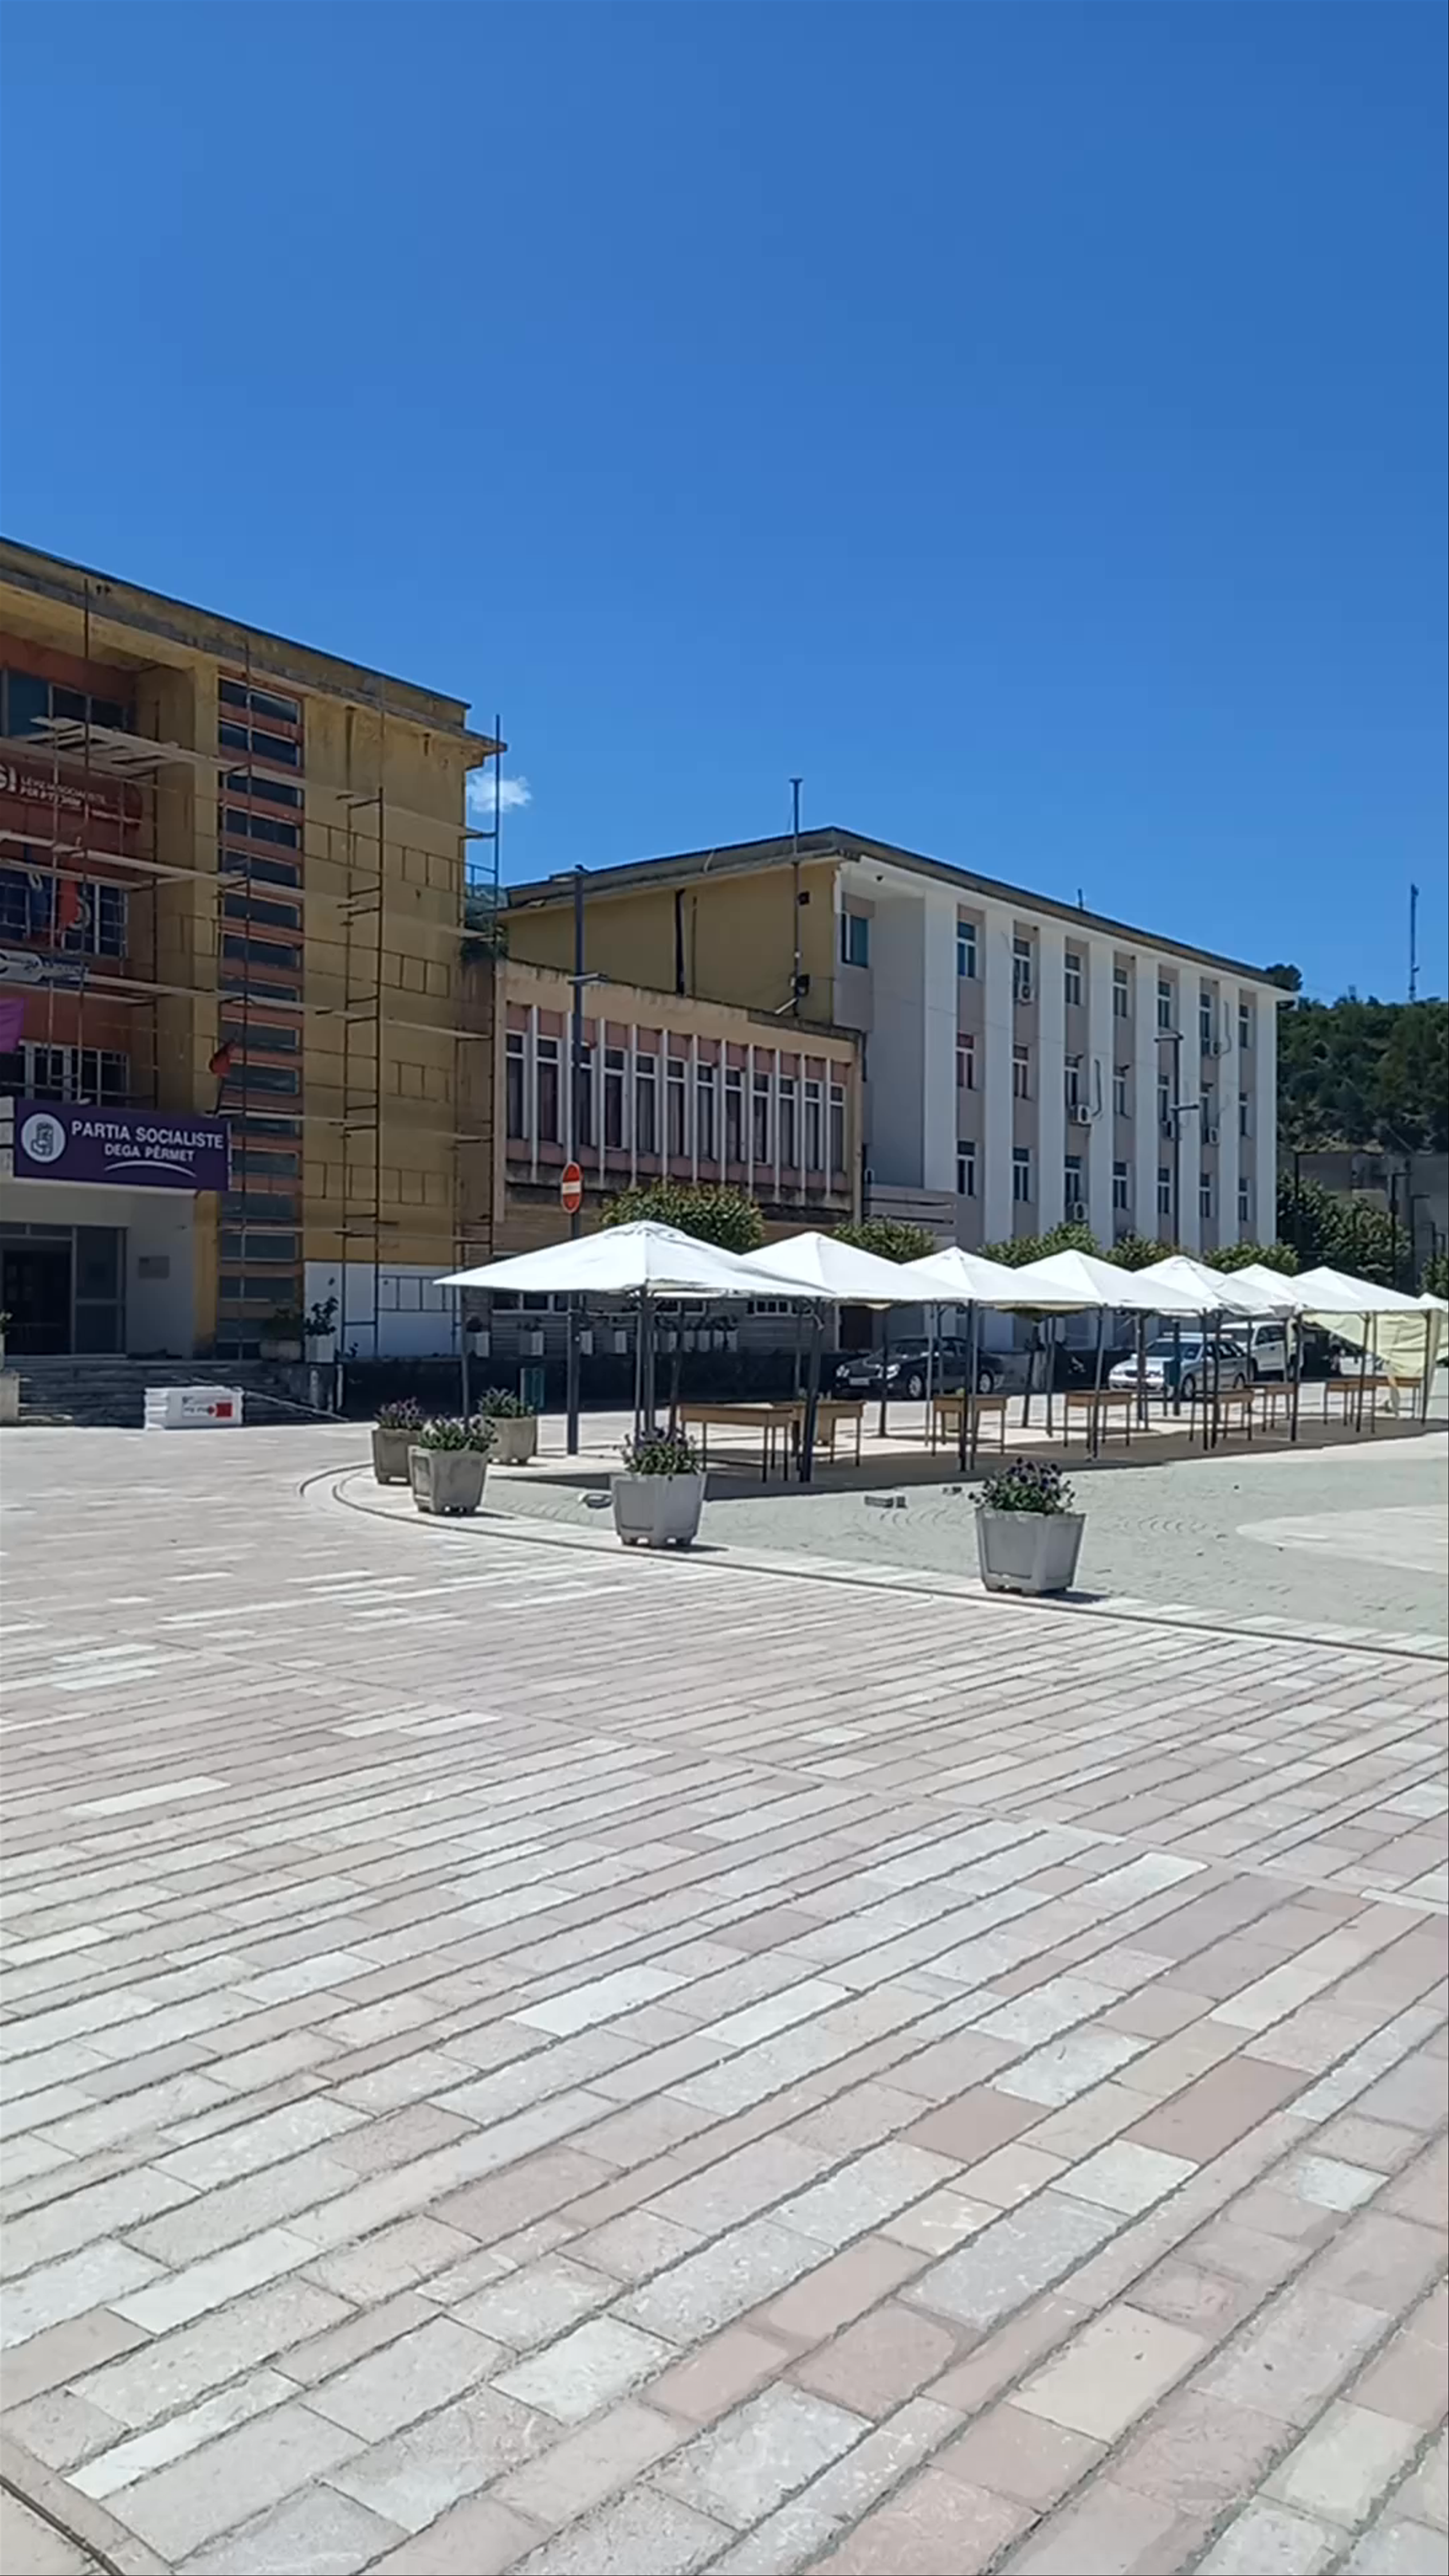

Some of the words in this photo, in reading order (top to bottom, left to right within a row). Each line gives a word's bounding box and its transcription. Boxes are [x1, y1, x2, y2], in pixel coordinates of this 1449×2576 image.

[71, 1121, 131, 1140] PARTIA
[136, 1127, 224, 1149] SOCIALISTE
[105, 1143, 140, 1157] DEGA
